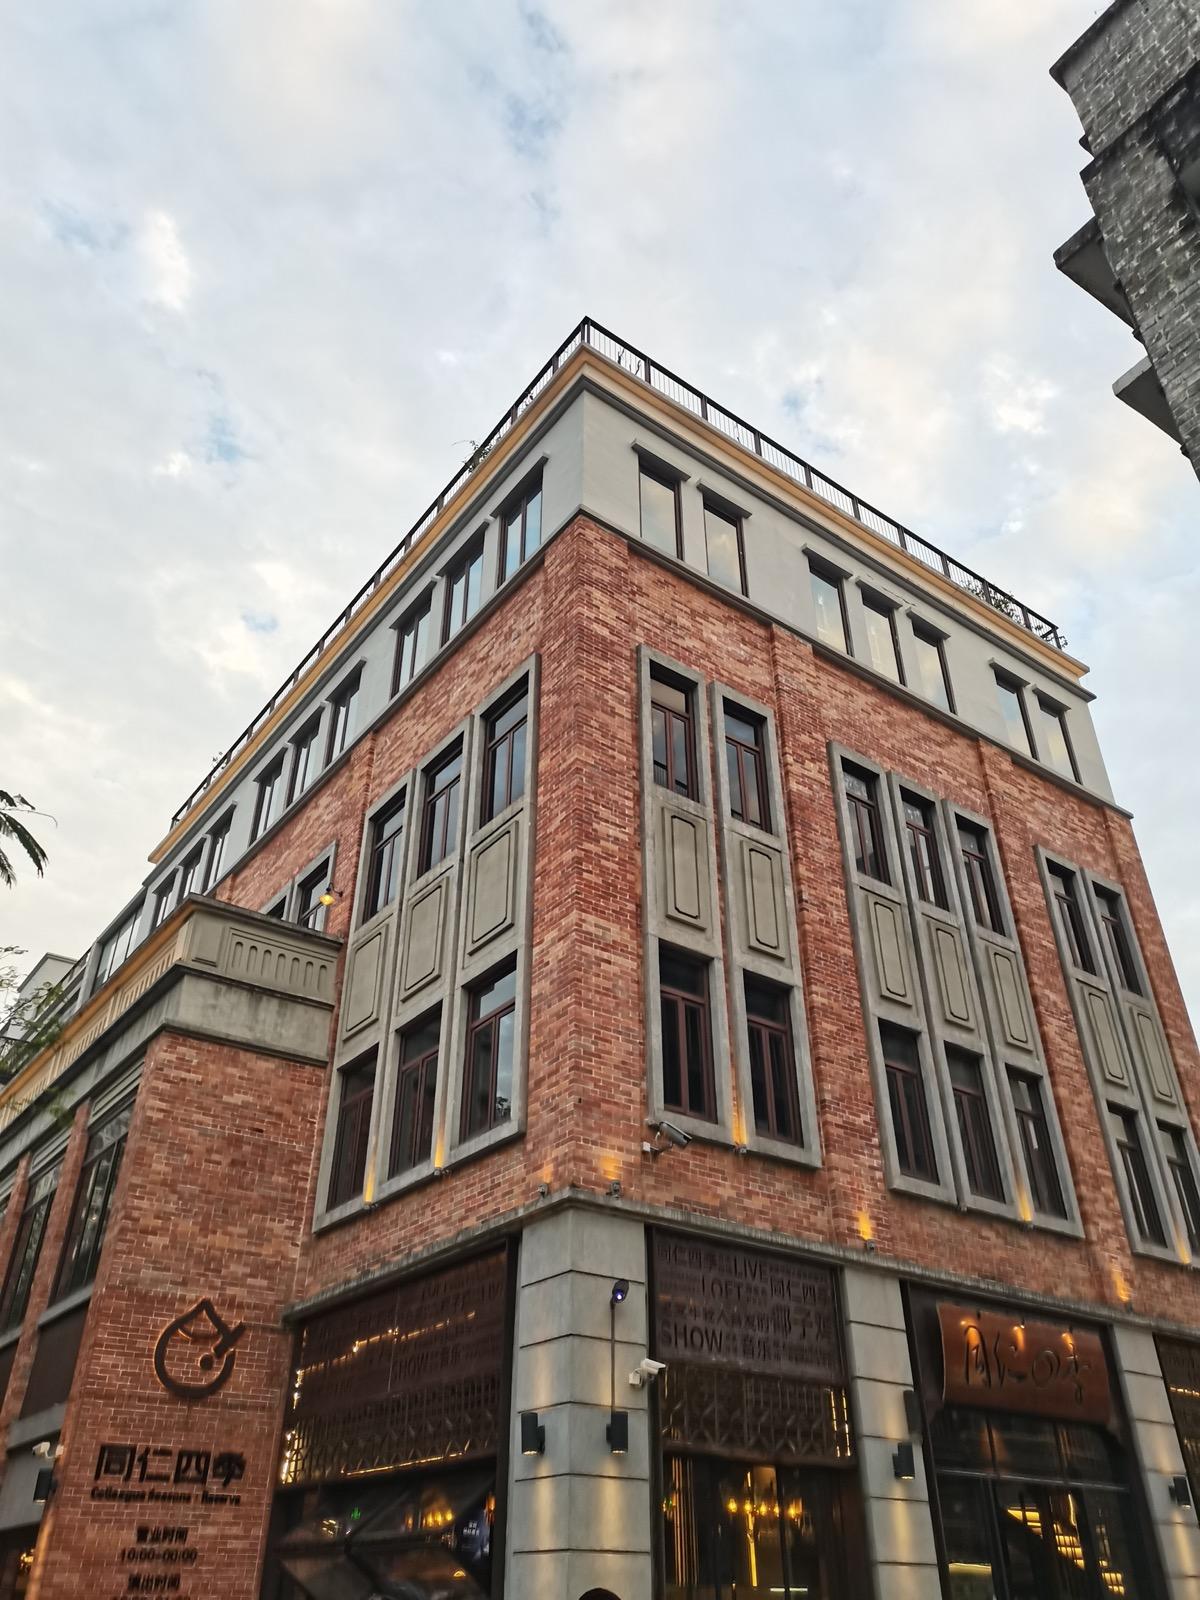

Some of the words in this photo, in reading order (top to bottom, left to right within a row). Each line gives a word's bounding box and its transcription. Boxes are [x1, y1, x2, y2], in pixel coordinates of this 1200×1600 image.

[733, 1255, 768, 1283] LIVE
[702, 1275, 742, 1301] LOFT
[660, 1319, 723, 1354] SHOW
[94, 1445, 245, 1487] 同仁四季
